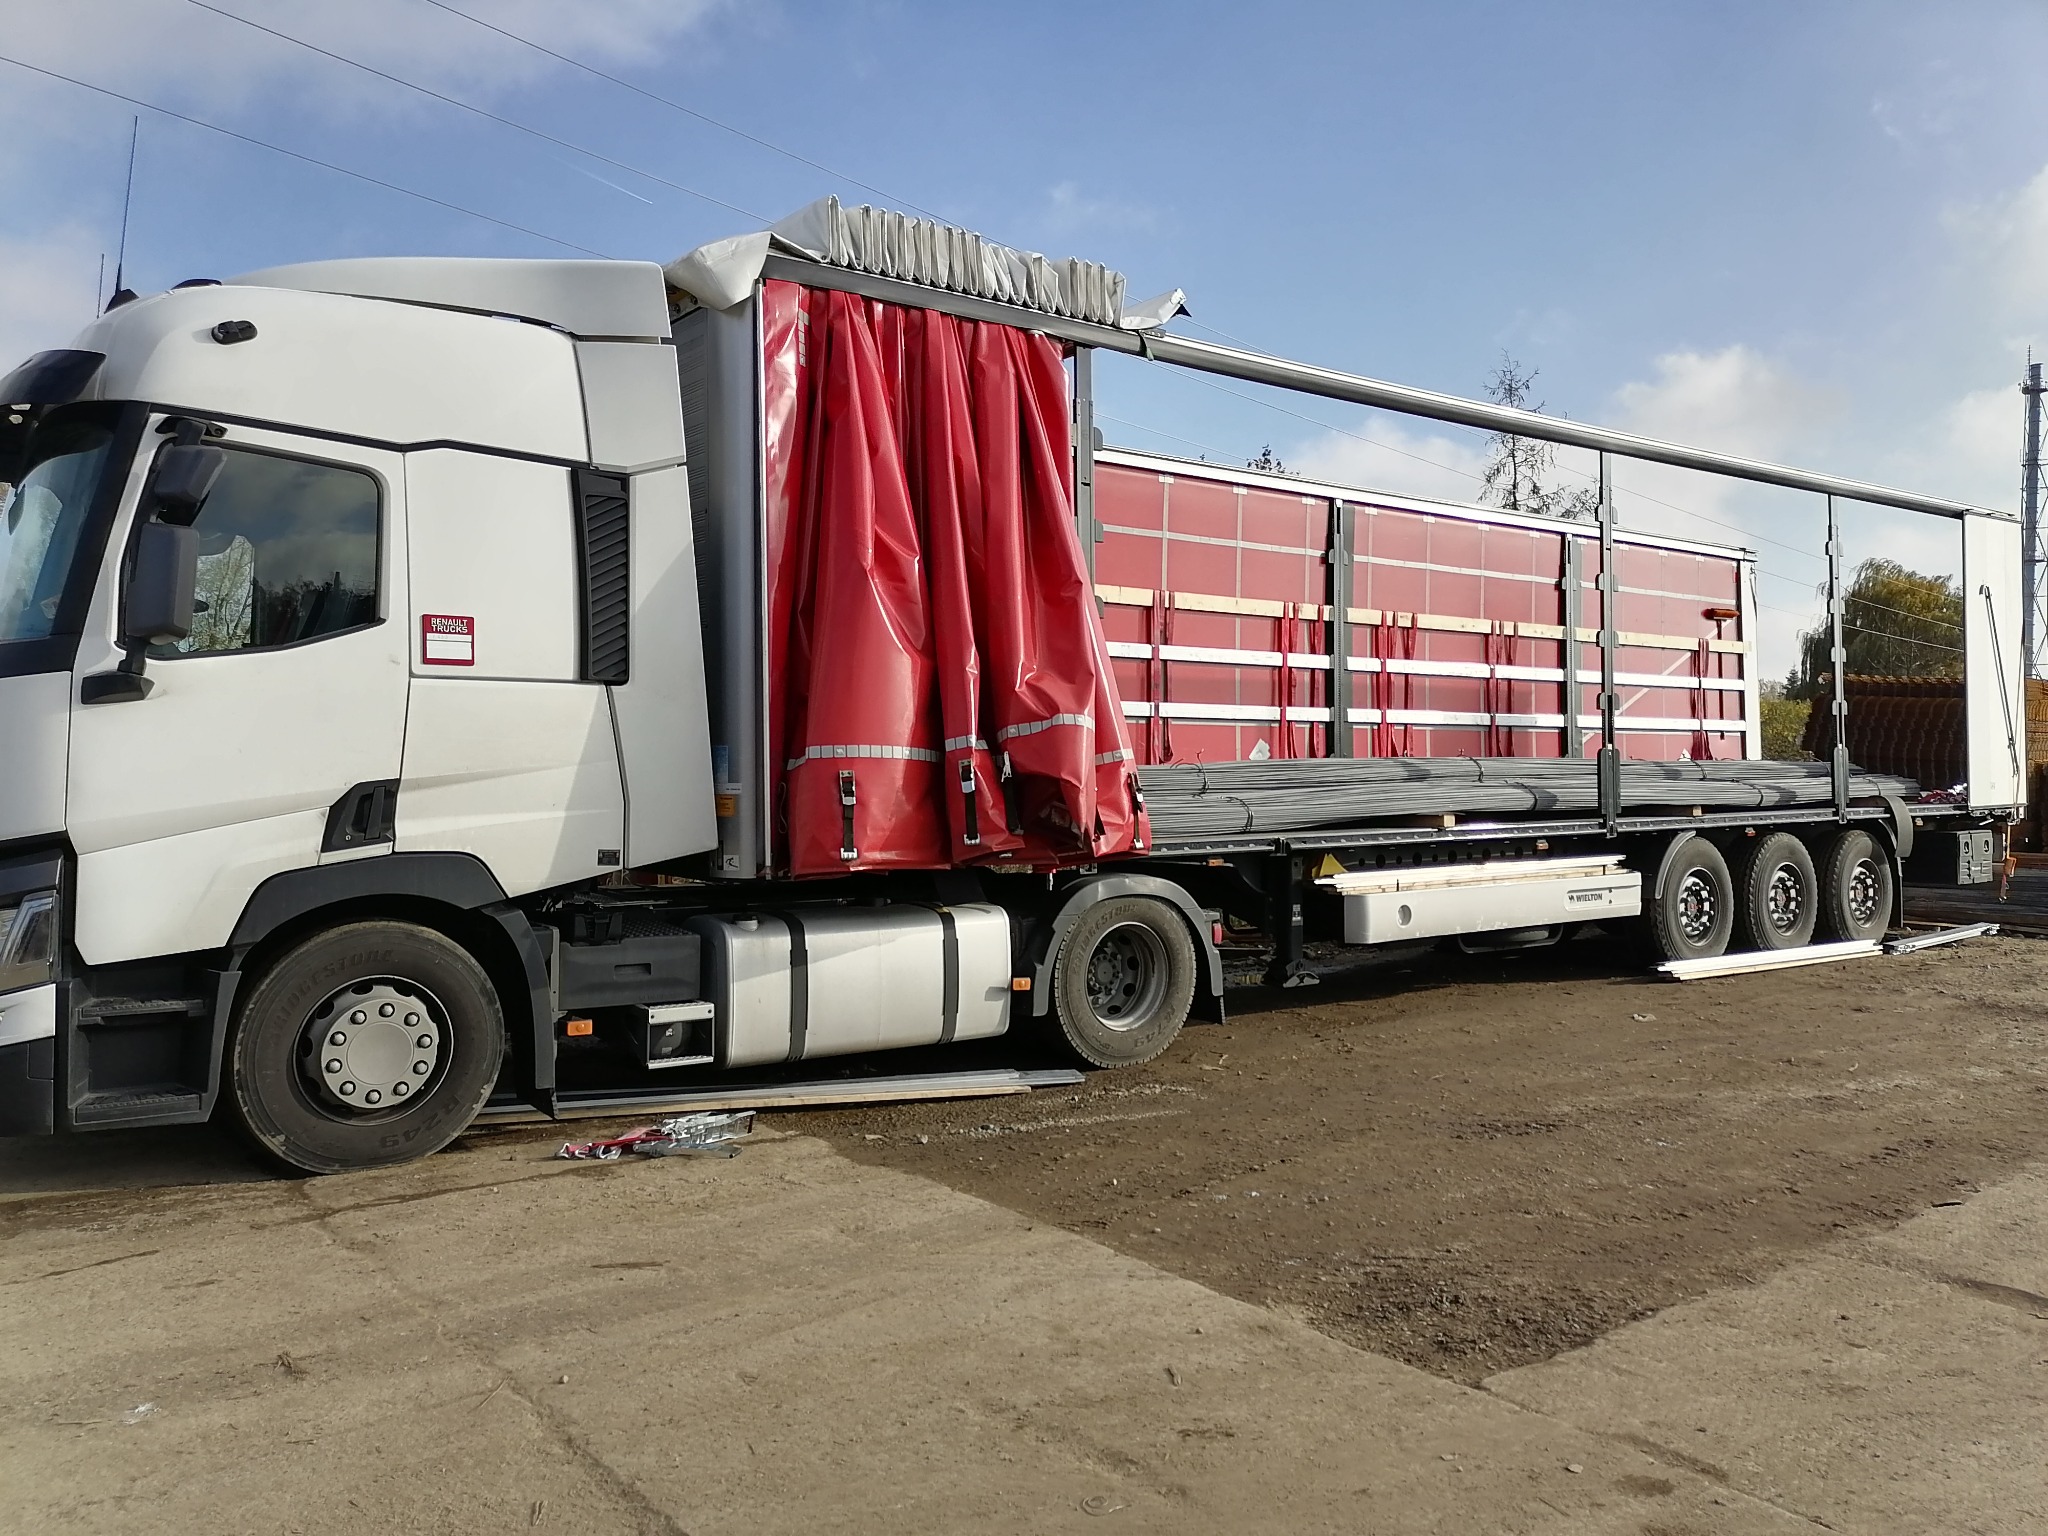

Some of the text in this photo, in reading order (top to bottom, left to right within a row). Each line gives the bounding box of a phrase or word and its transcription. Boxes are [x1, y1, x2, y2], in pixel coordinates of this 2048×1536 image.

[431, 618, 467, 626] RENAULT
[432, 625, 468, 633] TRUCKS
[1576, 893, 1602, 902] WIELTON
